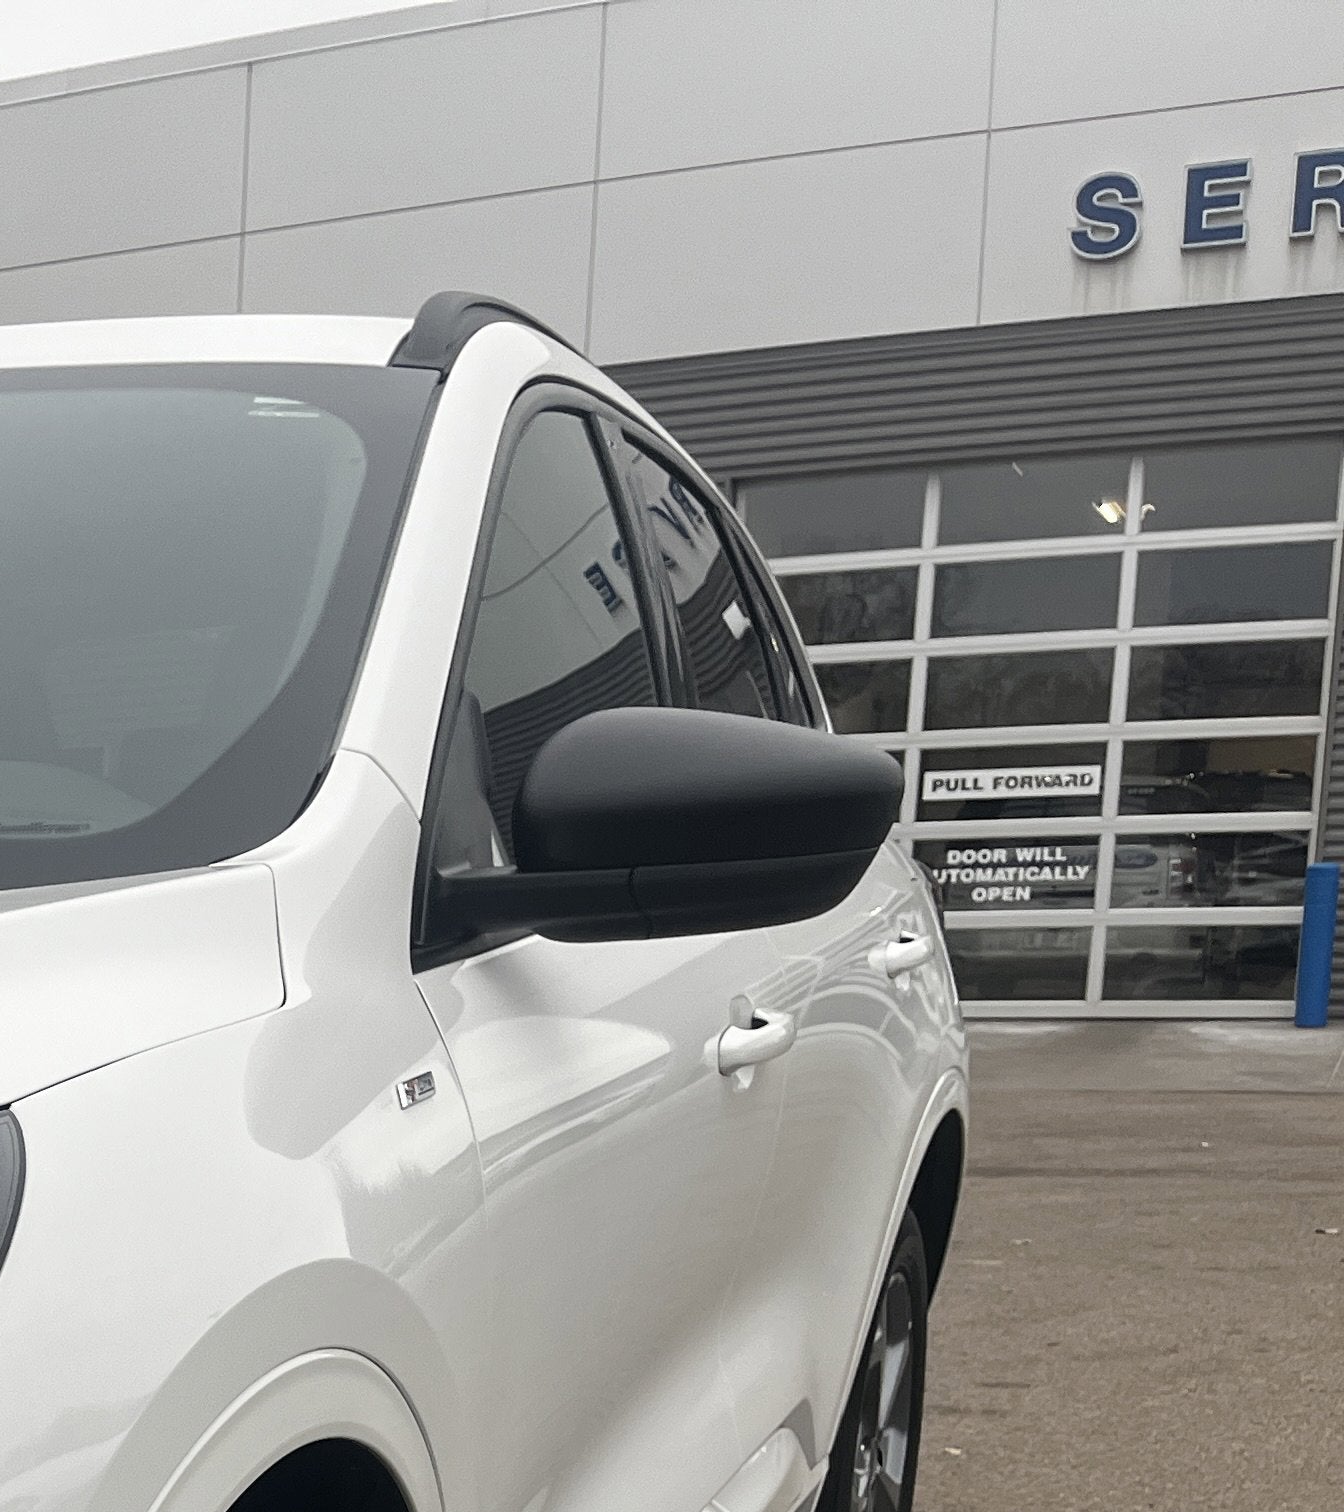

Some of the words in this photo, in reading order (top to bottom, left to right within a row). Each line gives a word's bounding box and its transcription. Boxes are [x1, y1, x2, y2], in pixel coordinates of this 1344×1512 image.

[931, 777, 984, 792] PULL
[992, 773, 1094, 790] FORWARD
[946, 848, 1007, 865] DOOR
[1016, 846, 1067, 862] WILL
[932, 865, 1090, 884] UTOMATICALLY
[970, 886, 1032, 902] OPEN
